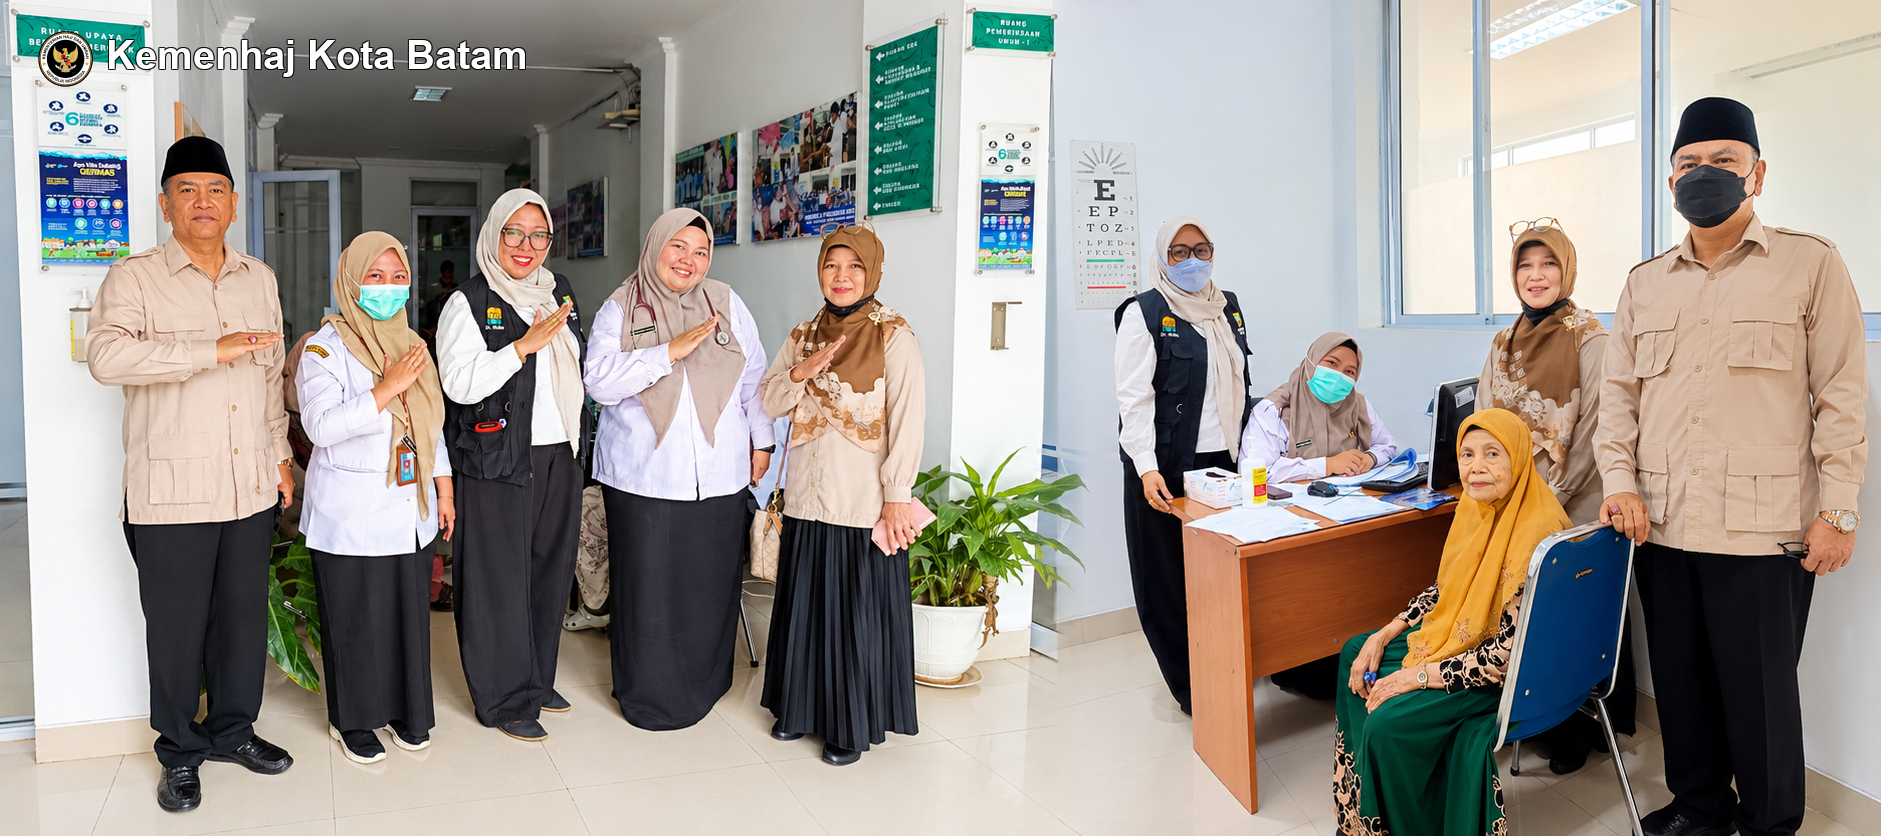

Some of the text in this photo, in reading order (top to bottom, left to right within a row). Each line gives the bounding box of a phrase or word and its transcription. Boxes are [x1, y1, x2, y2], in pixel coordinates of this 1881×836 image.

[65, 112, 79, 126] 6
[998, 149, 1007, 160] 6
[1093, 179, 1116, 202] E
